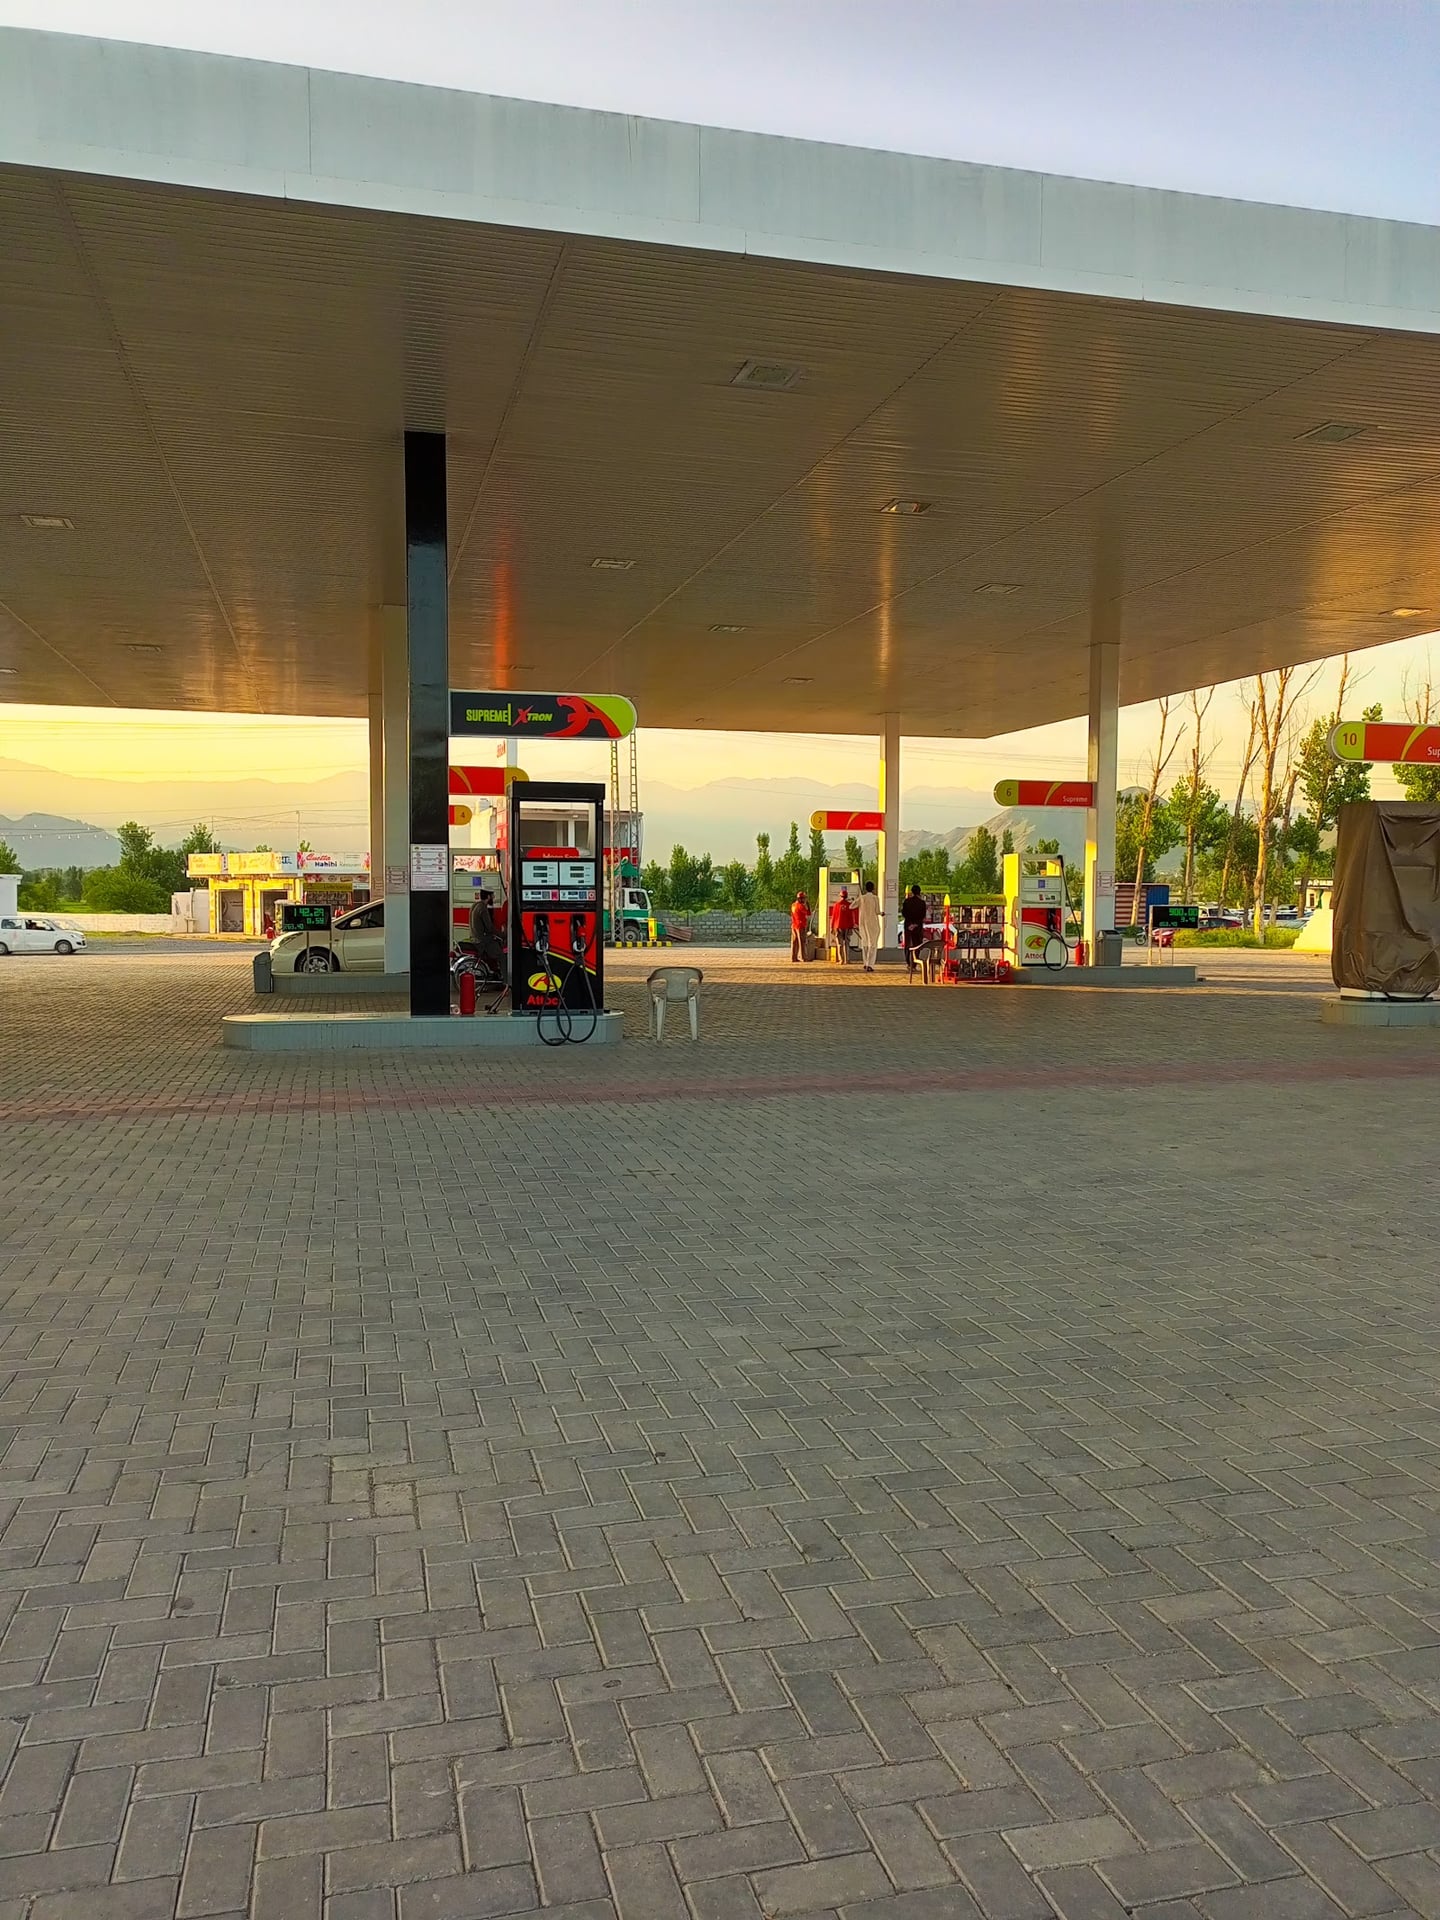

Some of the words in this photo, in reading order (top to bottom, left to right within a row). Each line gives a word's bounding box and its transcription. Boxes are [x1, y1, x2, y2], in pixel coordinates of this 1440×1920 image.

[466, 708, 509, 722] SUPREME
[1343, 732, 1357, 746] 10
[1006, 788, 1012, 797] 6
[1062, 795, 1088, 803] Supreme
[818, 816, 823, 824] 2
